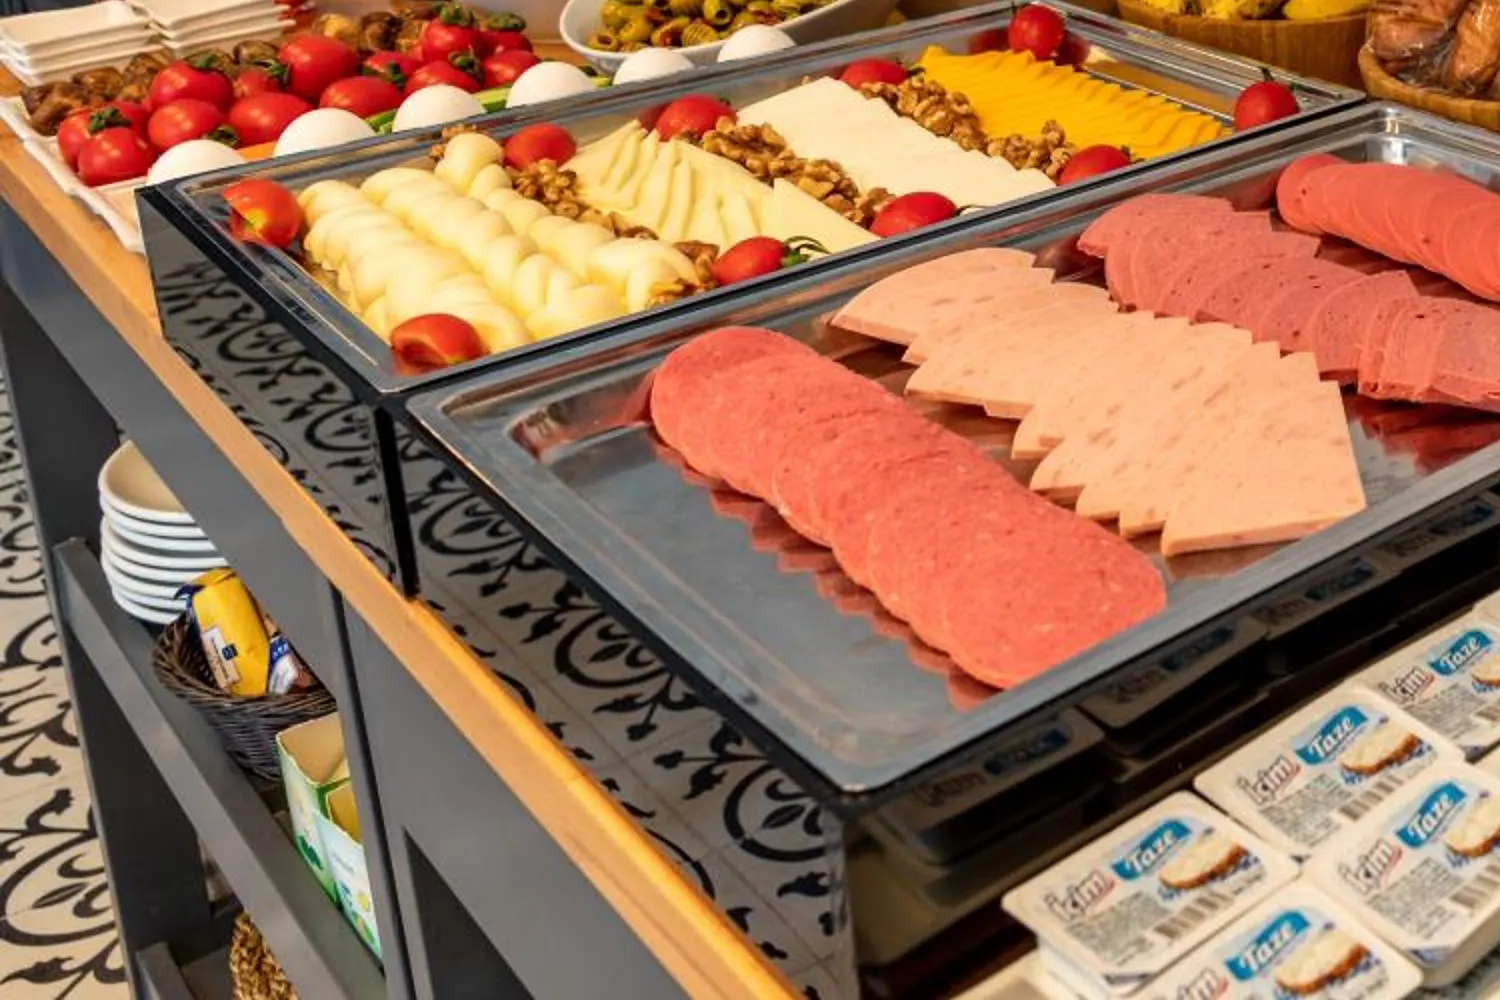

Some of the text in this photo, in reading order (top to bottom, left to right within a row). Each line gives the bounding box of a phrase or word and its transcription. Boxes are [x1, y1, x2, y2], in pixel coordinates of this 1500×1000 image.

[1441, 636, 1481, 670] Taze
[1308, 716, 1353, 759] Taze
[1408, 792, 1452, 841] Taze
[1124, 828, 1176, 873] Taze
[1238, 920, 1293, 971] Taze
